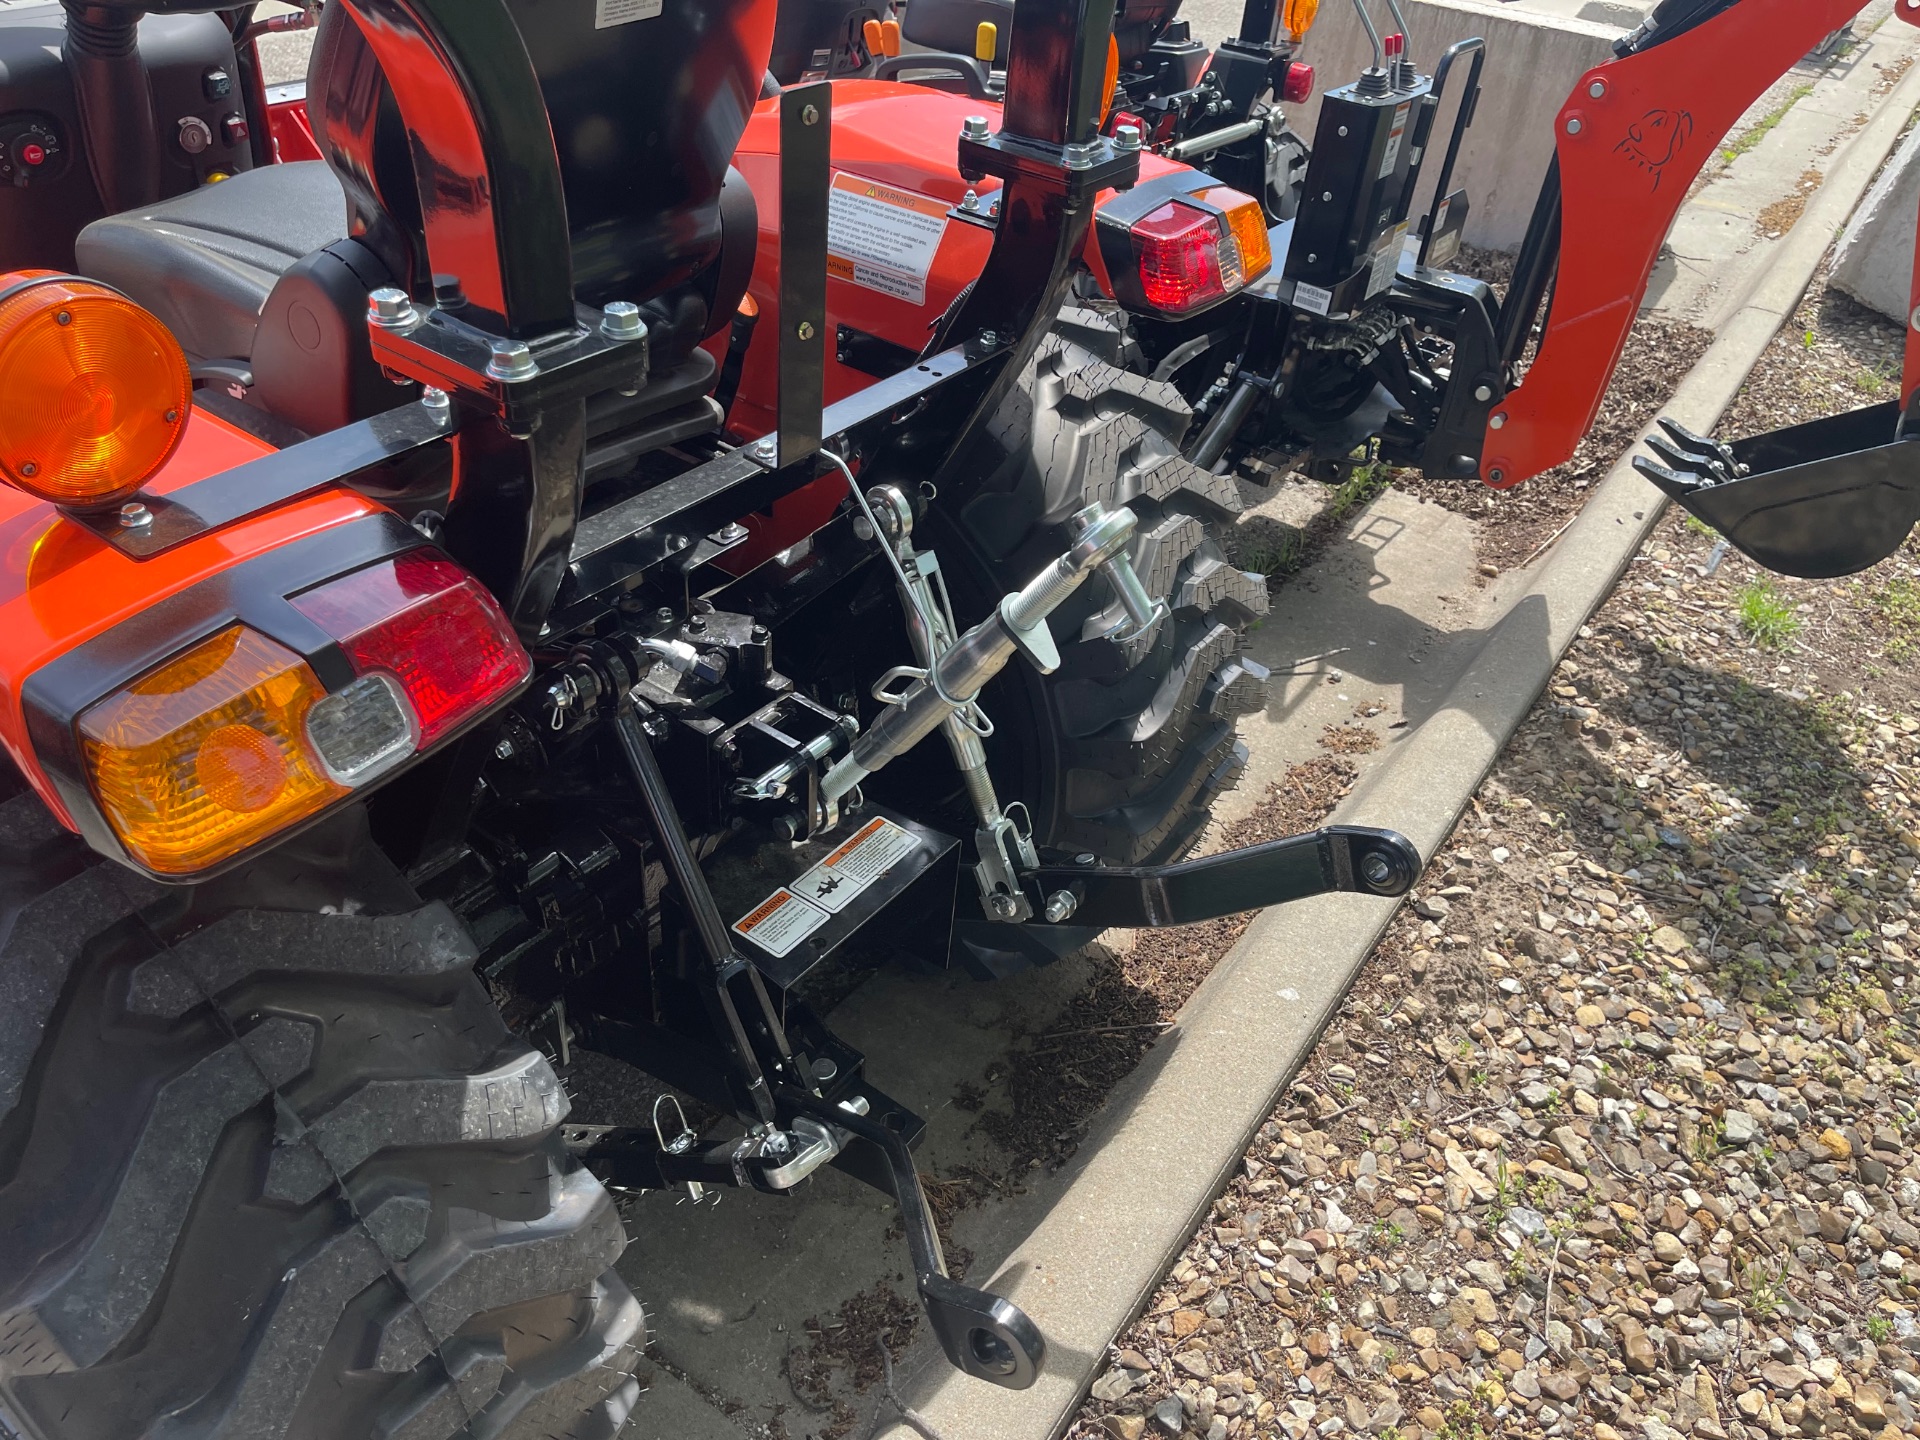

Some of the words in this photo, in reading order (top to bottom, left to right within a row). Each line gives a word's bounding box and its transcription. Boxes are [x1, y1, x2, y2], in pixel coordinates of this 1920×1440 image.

[877, 190, 915, 207] WARNING
[853, 203, 868, 213] California
[913, 223, 926, 231] defects
[871, 202, 884, 210] exhaust
[884, 207, 899, 215] exposes
[911, 214, 928, 223] chemicals
[832, 242, 852, 252] information
[875, 234, 889, 242] exhaust
[876, 241, 890, 249] exhaust
[828, 261, 853, 274] ARNING
[855, 266, 870, 275] Cancer
[870, 270, 879, 278] and
[880, 272, 907, 287] Reproductive
[845, 829, 872, 850] WARNING
[751, 896, 786, 923] WARNING
